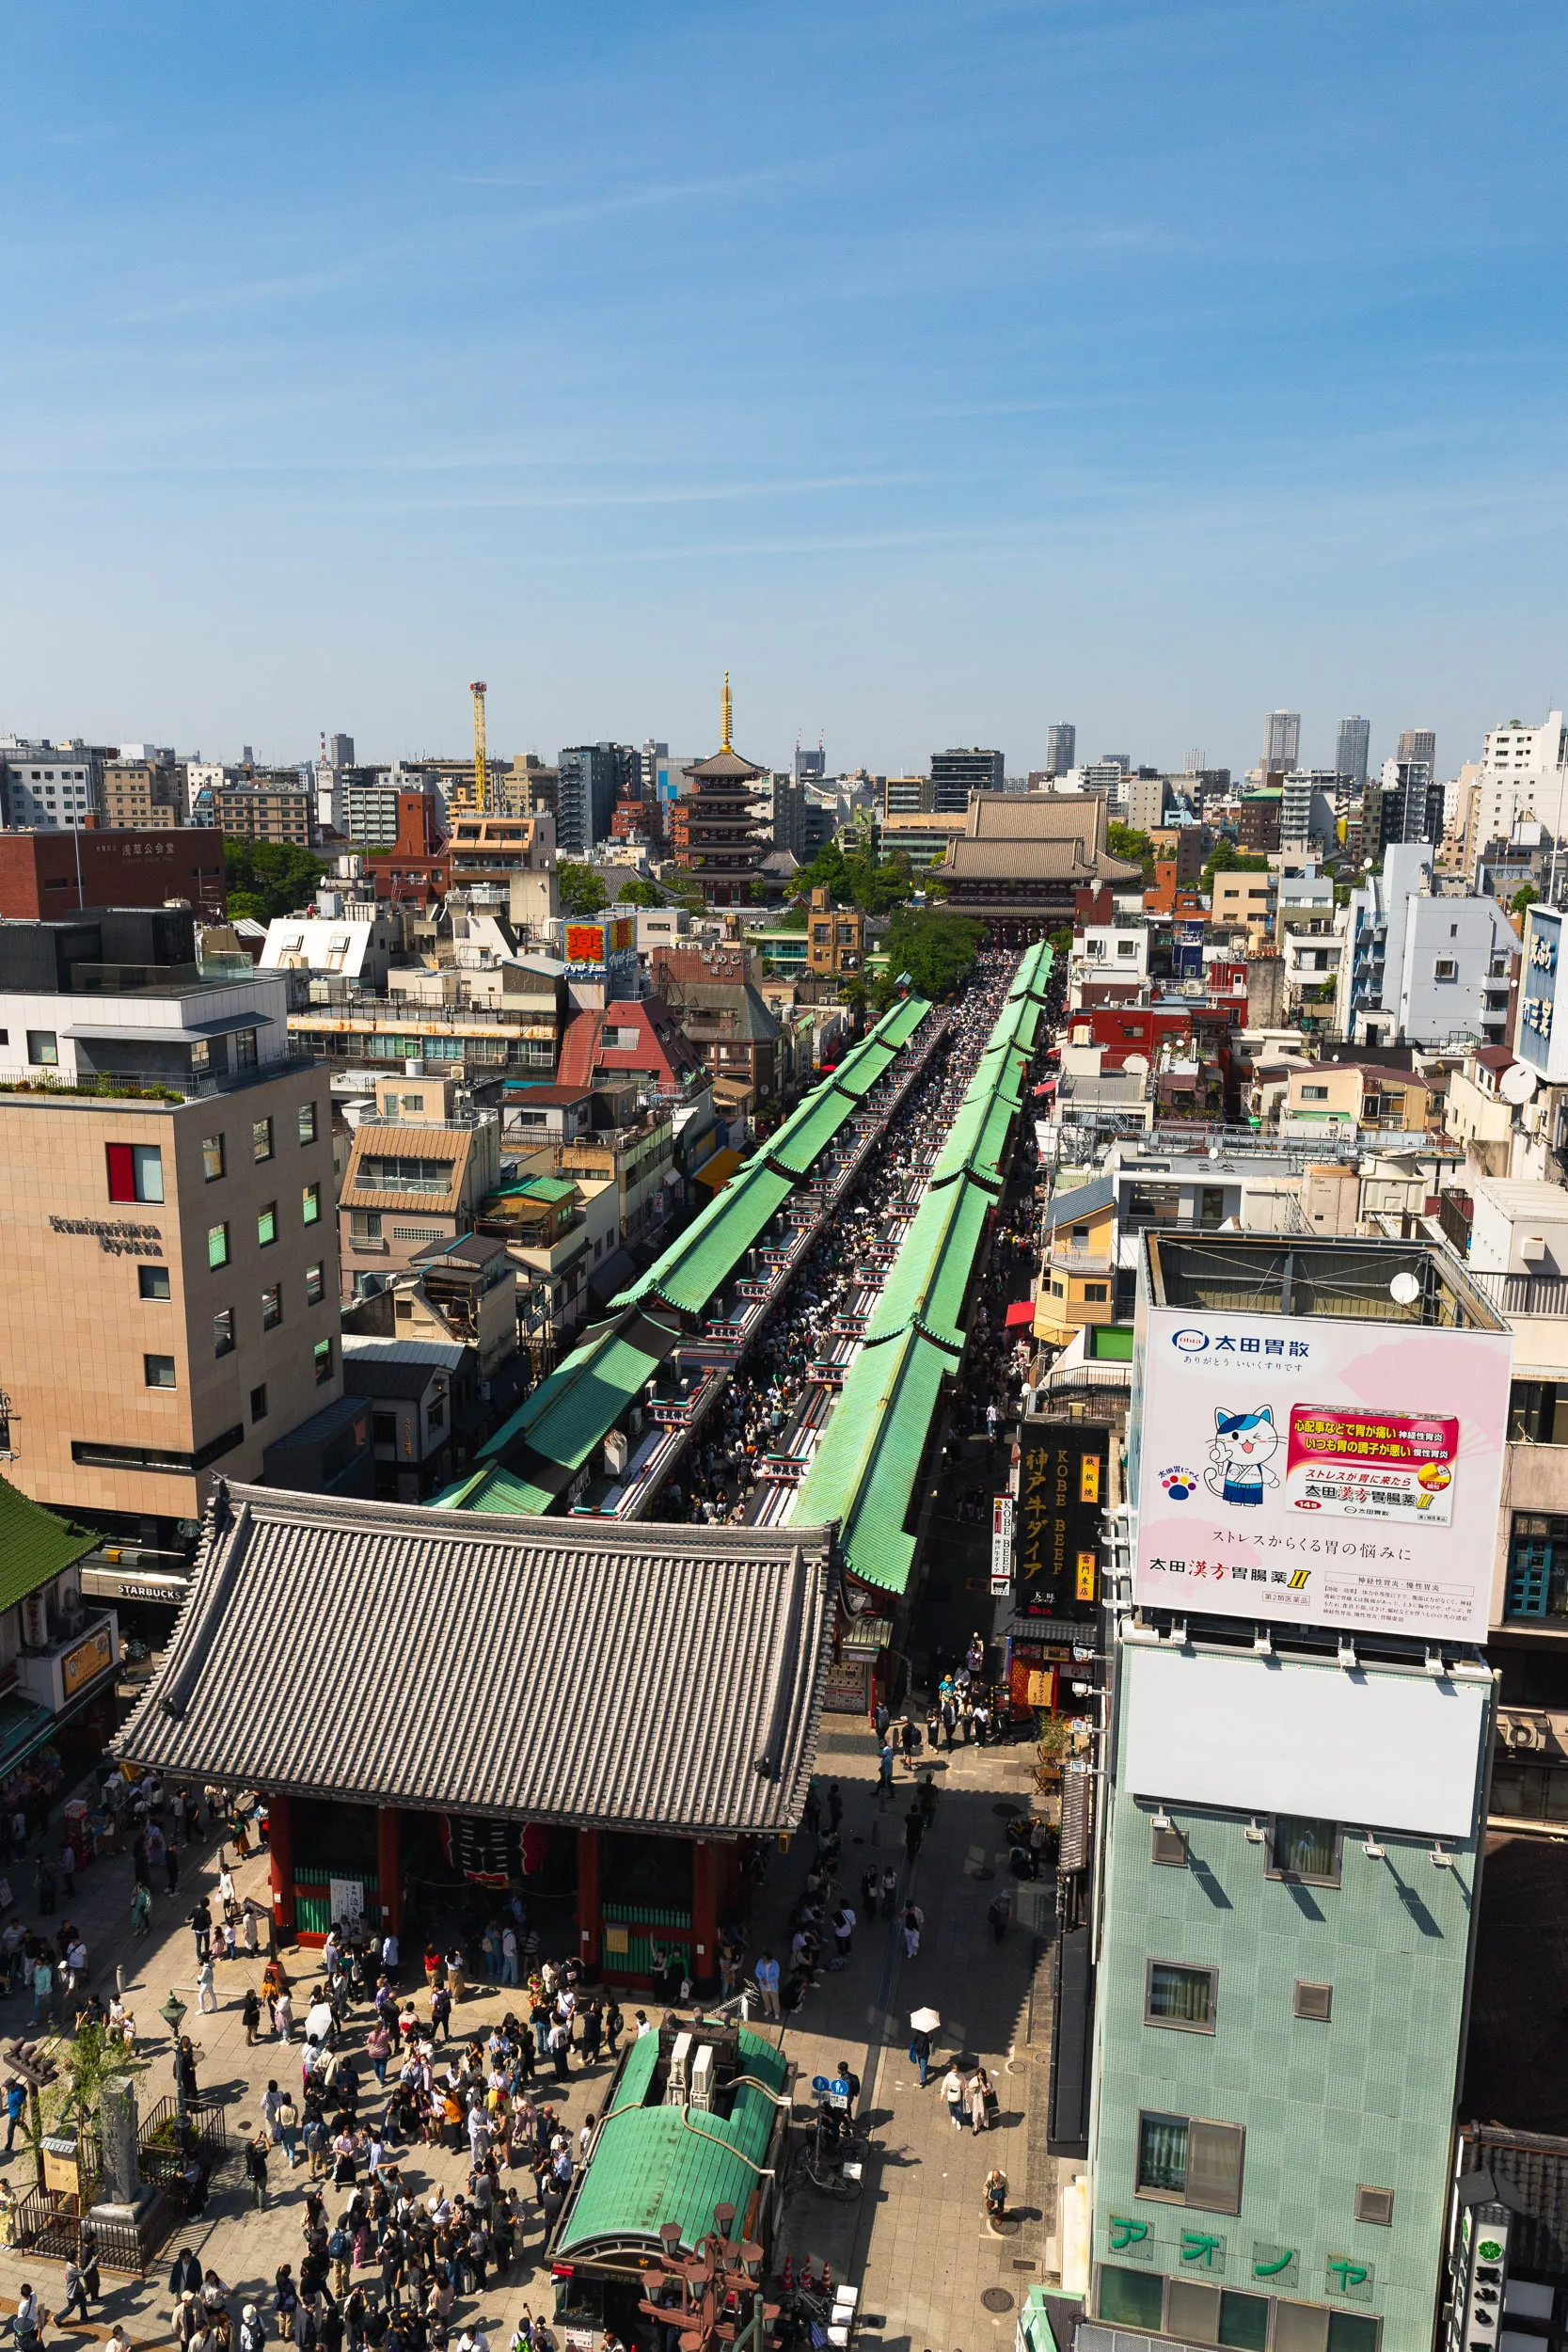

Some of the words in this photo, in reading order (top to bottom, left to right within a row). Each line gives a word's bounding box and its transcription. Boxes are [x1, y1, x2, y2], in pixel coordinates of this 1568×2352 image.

[121, 842, 175, 856] 浅草公会堂
[568, 926, 604, 961] 薬
[48, 1215, 158, 1233] Kaminarimon
[99, 1234, 158, 1252] Ryokan
[1214, 1335, 1310, 1358] 太田胃散
[1183, 1356, 1229, 1367] ありがとう
[1236, 1359, 1303, 1373] いいくすりです
[1294, 1419, 1397, 1439] 心配事などで胃が痛い
[1398, 1430, 1444, 1442] 神経性胃炎
[1305, 1437, 1411, 1458] いつも胃の調子が悪い
[1413, 1448, 1449, 1459] 慢性胃炎
[1055, 1450, 1069, 1507] KOBE
[1084, 1457, 1096, 1498] 鉄板焼
[1158, 1465, 1200, 1483] 太田胃にゃん
[1003, 1500, 1011, 1536] KOBE
[1023, 1447, 1049, 1580] 神戸牛ダイア
[1358, 1507, 1389, 1516] 太田胃散
[1002, 1539, 1010, 1574] BEEF
[1053, 1519, 1067, 1576] BEEF
[1212, 1530, 1411, 1561] ストレスからくる胃の悩みに
[1079, 1555, 1091, 1597] 雷門東店
[1357, 1576, 1440, 1592] 神経性胃炎・慢性胃炎
[118, 1584, 182, 1599] STARBUCKS
[1112, 2218, 1368, 2292] アオノヤ
[1474, 2265, 1500, 2325] 天ぷら
